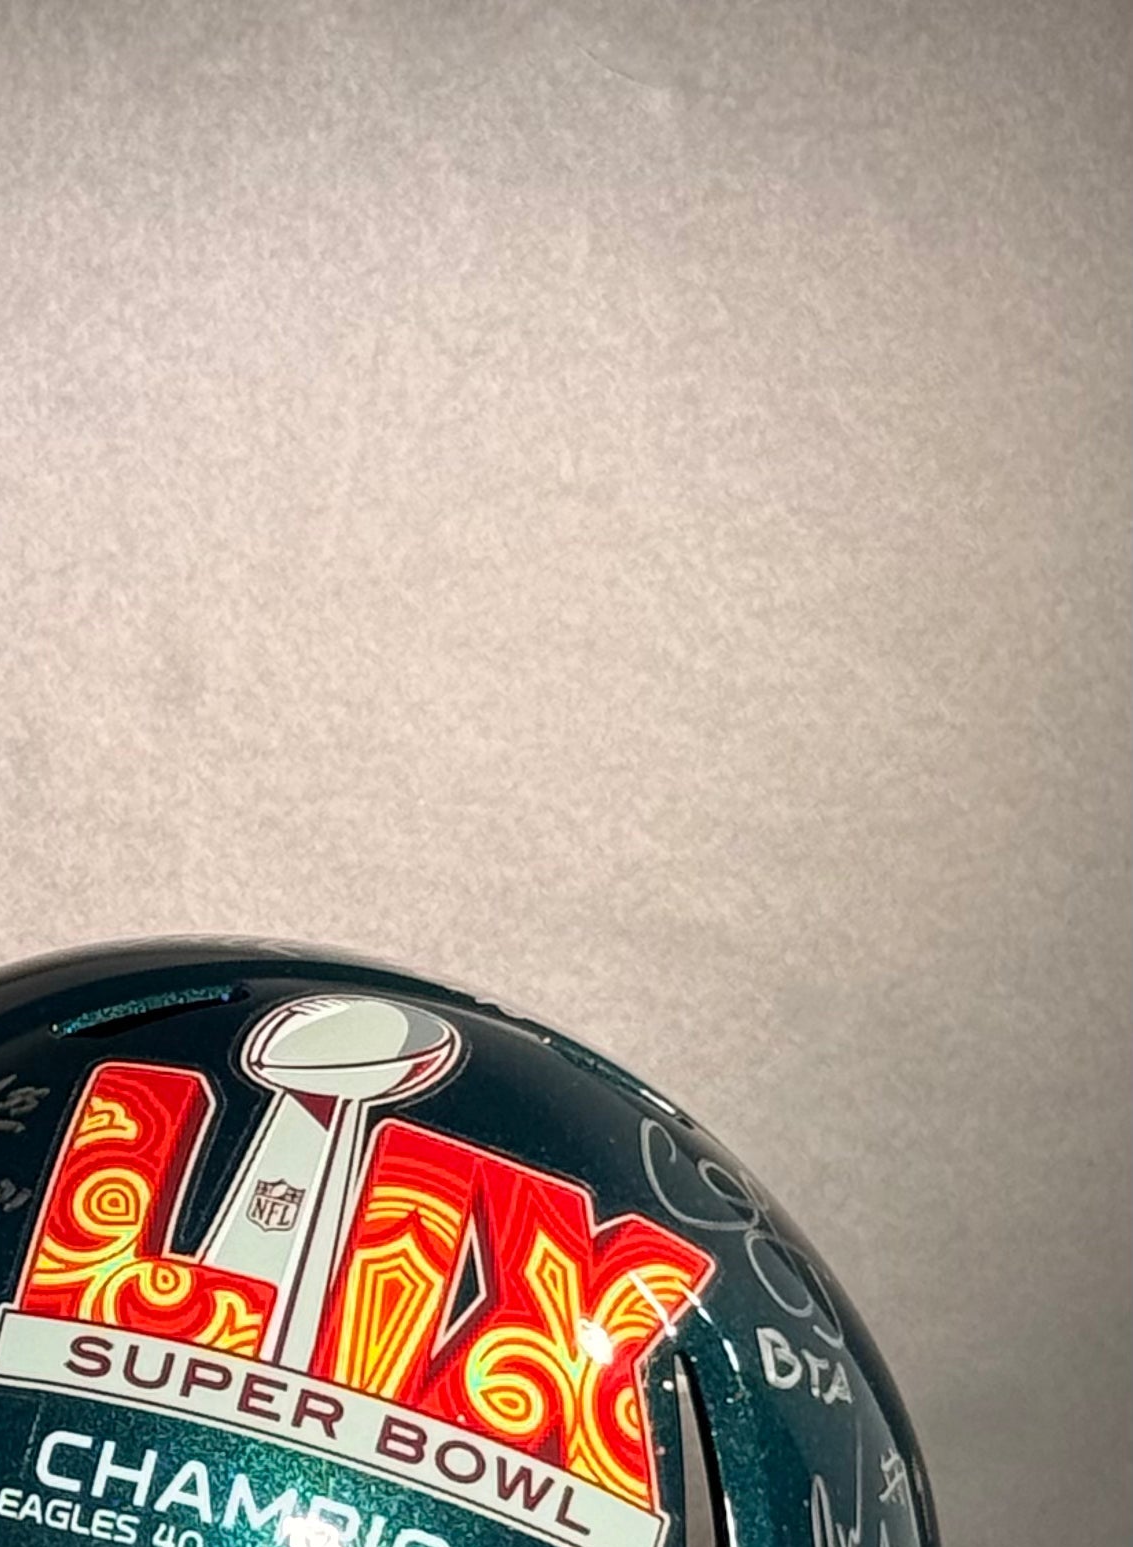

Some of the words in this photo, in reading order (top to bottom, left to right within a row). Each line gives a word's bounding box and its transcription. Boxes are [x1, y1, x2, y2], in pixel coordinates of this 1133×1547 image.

[250, 1201, 291, 1226] NFL
[63, 1335, 345, 1440] SUPER
[375, 1414, 591, 1536] BOWL
